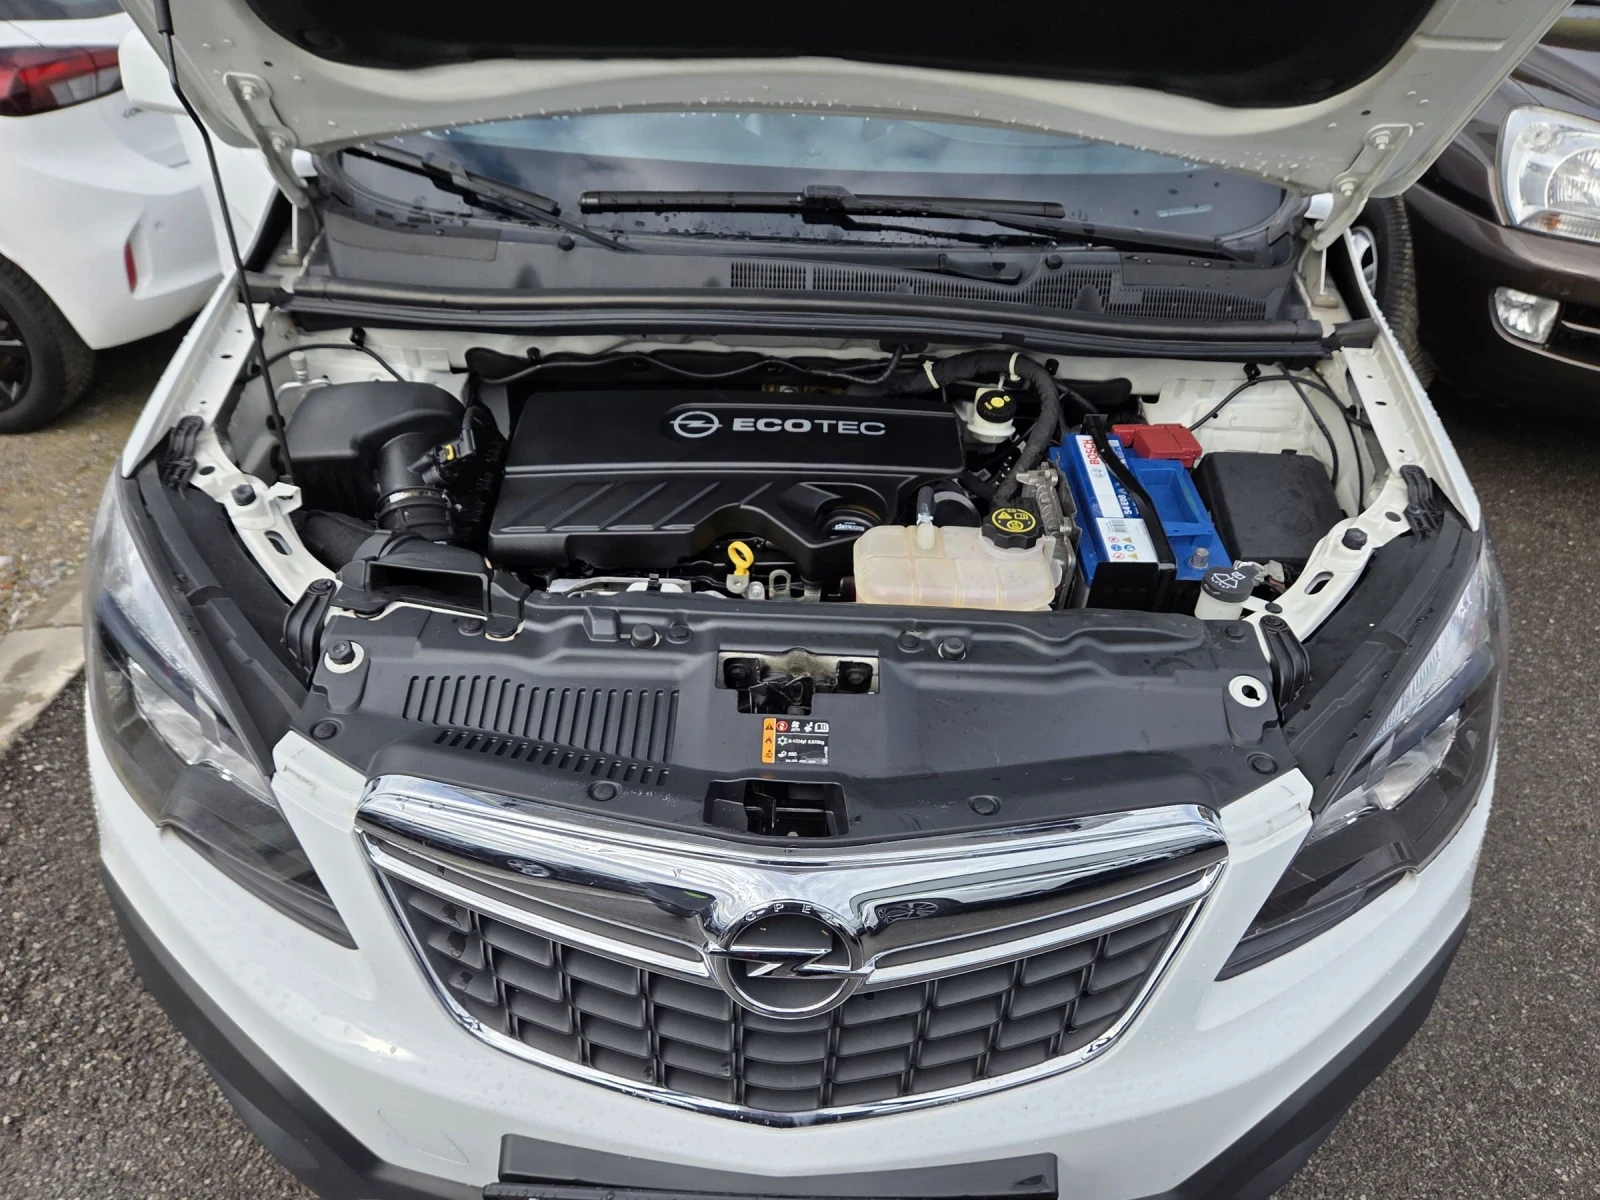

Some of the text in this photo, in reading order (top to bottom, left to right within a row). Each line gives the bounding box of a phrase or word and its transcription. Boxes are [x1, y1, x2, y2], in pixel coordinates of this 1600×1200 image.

[732, 417, 886, 436] ECOTEC
[1083, 439, 1100, 465] BOSCH
[834, 523, 865, 532] dexos
[745, 903, 840, 926] OPEL
